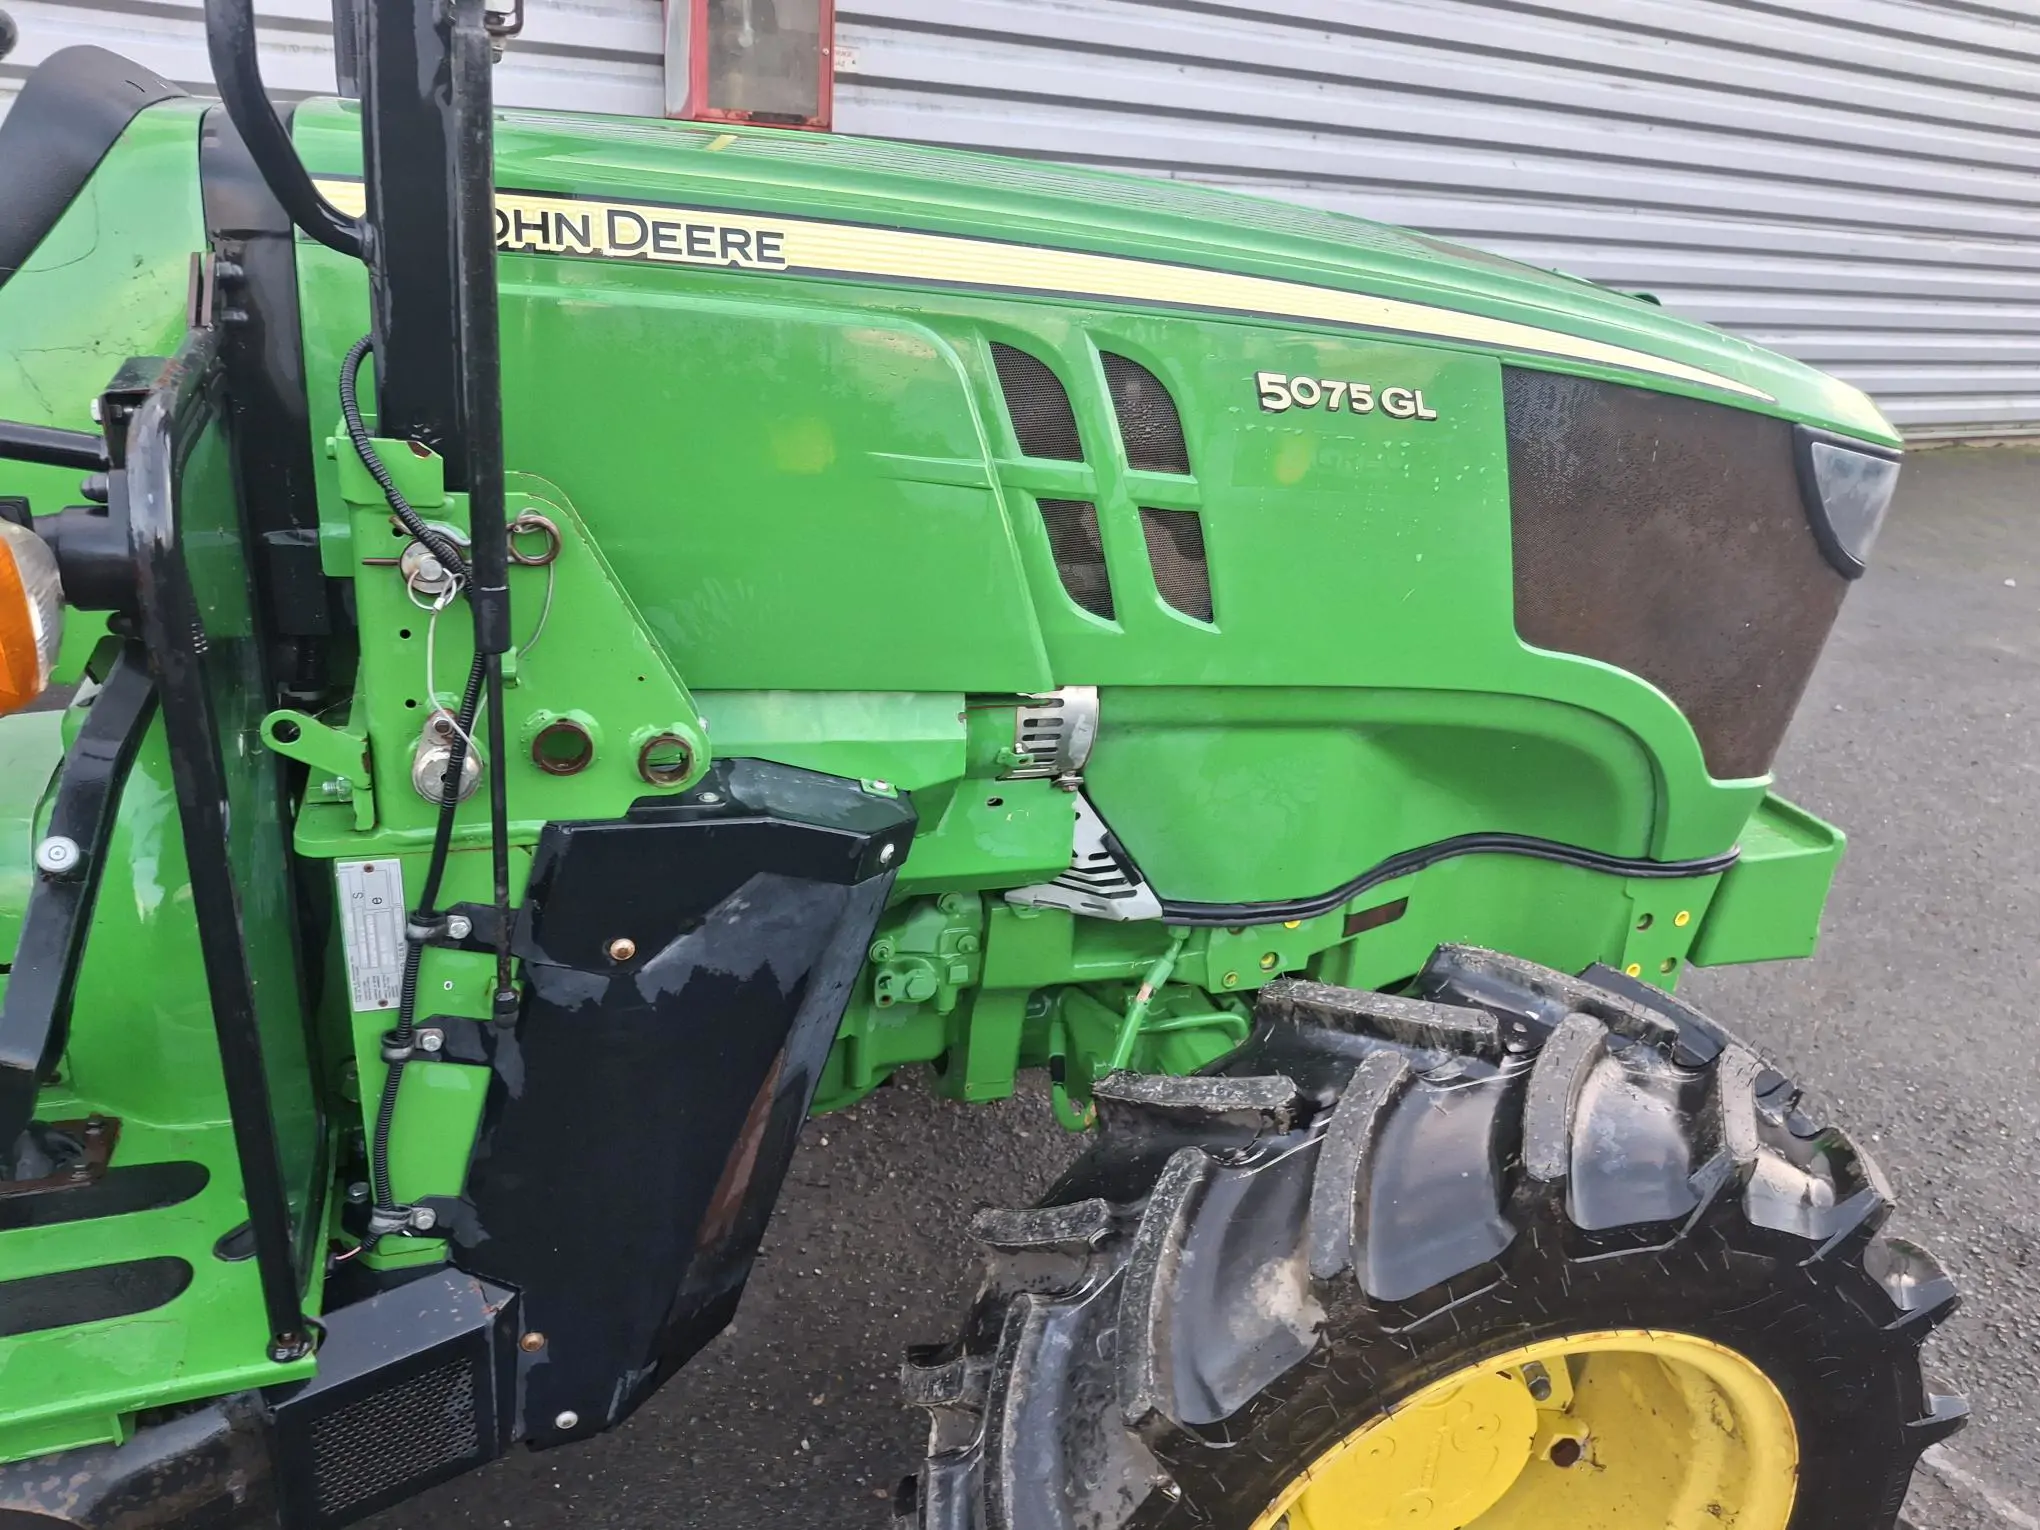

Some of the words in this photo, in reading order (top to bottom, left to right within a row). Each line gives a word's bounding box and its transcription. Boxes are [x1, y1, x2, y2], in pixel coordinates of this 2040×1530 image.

[606, 209, 786, 264] DEERE
[1257, 371, 1375, 414] 5075
[1380, 386, 1437, 421] GL
